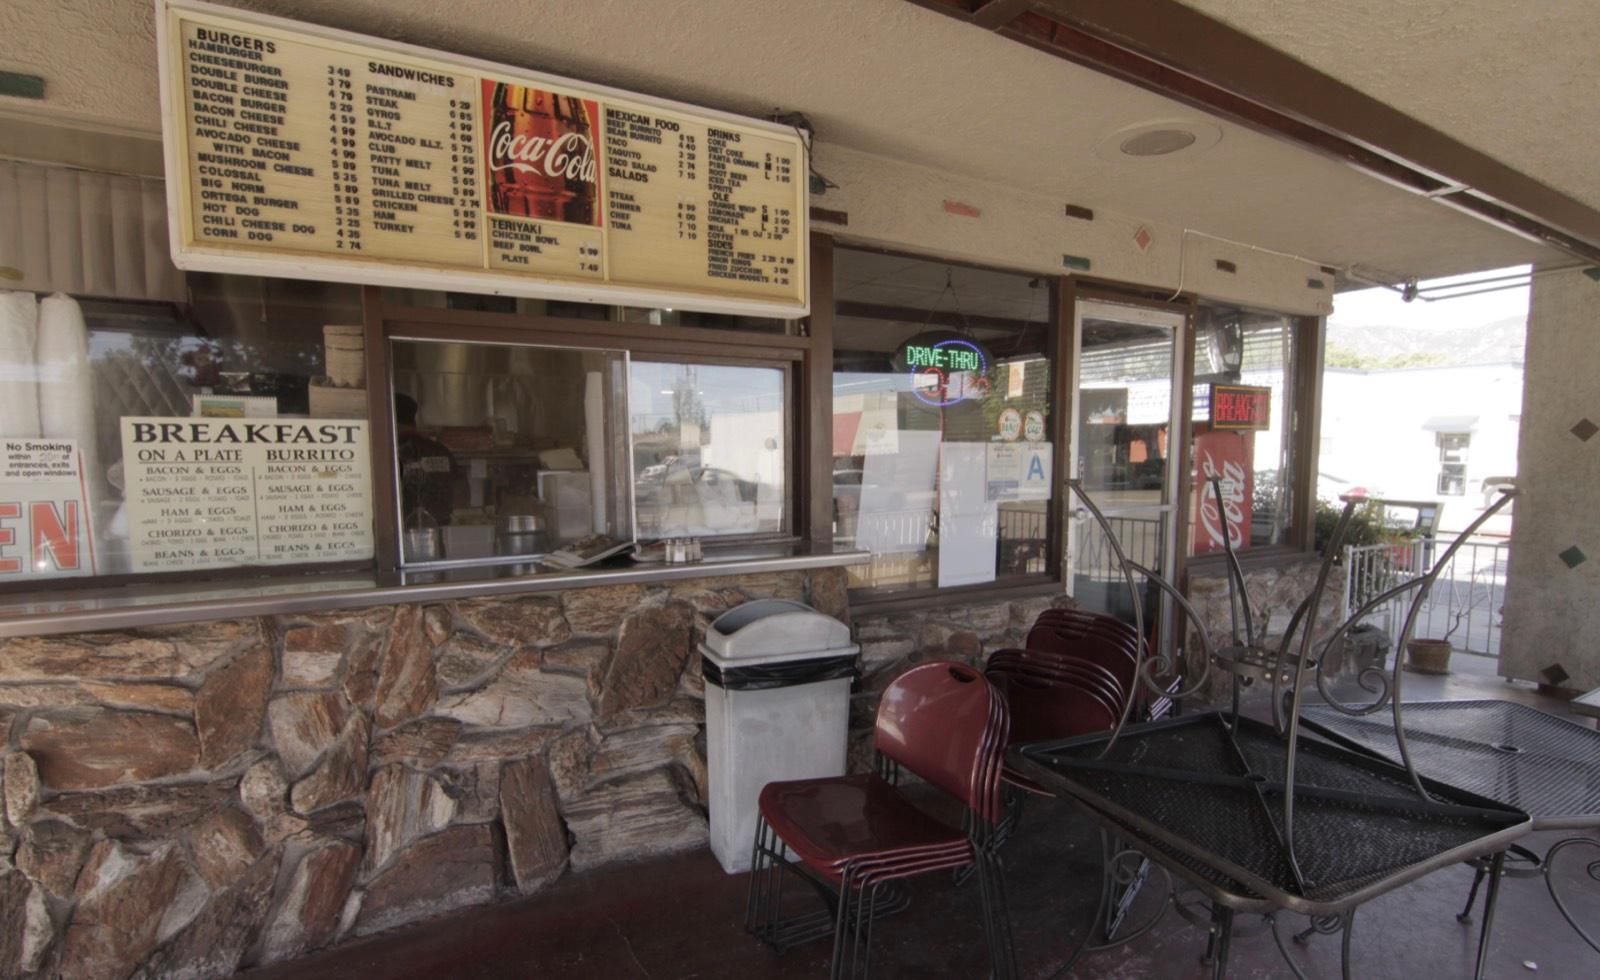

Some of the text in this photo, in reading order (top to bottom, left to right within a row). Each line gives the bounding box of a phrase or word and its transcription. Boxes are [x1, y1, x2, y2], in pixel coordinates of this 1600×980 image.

[197, 28, 276, 53] BURGERS
[189, 39, 262, 61] HAMBURGER
[190, 53, 282, 76] CHEESEBURGER
[191, 64, 288, 90] DOUBLE BURGER
[368, 62, 455, 88] SANDWICHES
[192, 77, 287, 102] DOUBLE CHEESE
[366, 84, 416, 101] PASTRAMI
[193, 90, 286, 113] BACON BURGER
[366, 96, 399, 109] STEAK
[194, 103, 284, 125] BACON CHEESE
[367, 108, 401, 121] GYROS
[607, 108, 680, 132] MEXICAN FOOD
[194, 115, 277, 136] CHILI CHEESE
[607, 119, 662, 137] BEEF BURRITO
[196, 128, 300, 151] AVOCADO CHEESE
[368, 131, 416, 145] AVOCADO
[607, 128, 662, 145] BEAN BURRITO
[607, 138, 628, 147] TACO
[707, 128, 741, 142] DRINKS
[213, 142, 290, 161] WITH BACON
[368, 142, 396, 154] CLUB
[489, 121, 596, 184] Coca-Cola
[608, 147, 641, 160] TAQUITO
[198, 153, 314, 177] MUSHROOM CHEESE
[370, 154, 431, 170] PATTY MELT
[609, 157, 657, 173] TACO SALAD
[199, 165, 262, 181] COLOSSAL
[371, 166, 400, 177] TUNA
[609, 167, 649, 183] SALADS
[201, 178, 265, 193] BIG NORM
[372, 177, 431, 192] TUNA MELT
[201, 191, 299, 209] ORTEGA BURGER
[372, 188, 455, 206] GRILLED CHEESE
[610, 191, 635, 202] STEAK
[203, 203, 260, 217] HOT DOG
[372, 200, 418, 212] CHICKEN
[610, 201, 641, 212] DINNER
[374, 211, 395, 221] HAM
[610, 211, 631, 221] CHEF
[203, 215, 315, 234] CHILI CHEESE DOG
[374, 221, 415, 233] TURKEY
[491, 219, 542, 235] TERIYAKI
[611, 221, 632, 231] TUNA
[203, 227, 273, 242] CORN DOG
[492, 230, 560, 246] CHICKEN BOWL
[493, 239, 542, 254] BEEF BOWL
[708, 240, 734, 250] SIDES
[502, 253, 529, 265] PLATE
[906, 345, 979, 370] DRIVE-THRU
[132, 423, 360, 444] BREAKFAST
[6, 442, 72, 453] No Smoking
[138, 449, 243, 461] ON A PLATE
[266, 449, 354, 461] BURRITO
[147, 465, 241, 475] BACON & EGGS
[267, 465, 306, 473] BACON
[325, 464, 353, 472] EGGS
[1027, 454, 1045, 481] A
[142, 486, 247, 496] SAUSAGE & EGGS
[268, 484, 310, 493] SAUSAGE
[328, 484, 354, 492] EGGS
[161, 506, 237, 517] HAM & EGGS
[279, 503, 347, 513] HAM & EGGS
[148, 527, 249, 538] CHORIZO & EGGS
[268, 522, 358, 533] CHORIZO & EGGS
[154, 547, 245, 559] BEANS & EGGS
[274, 541, 356, 552] BEANS & EGGS
